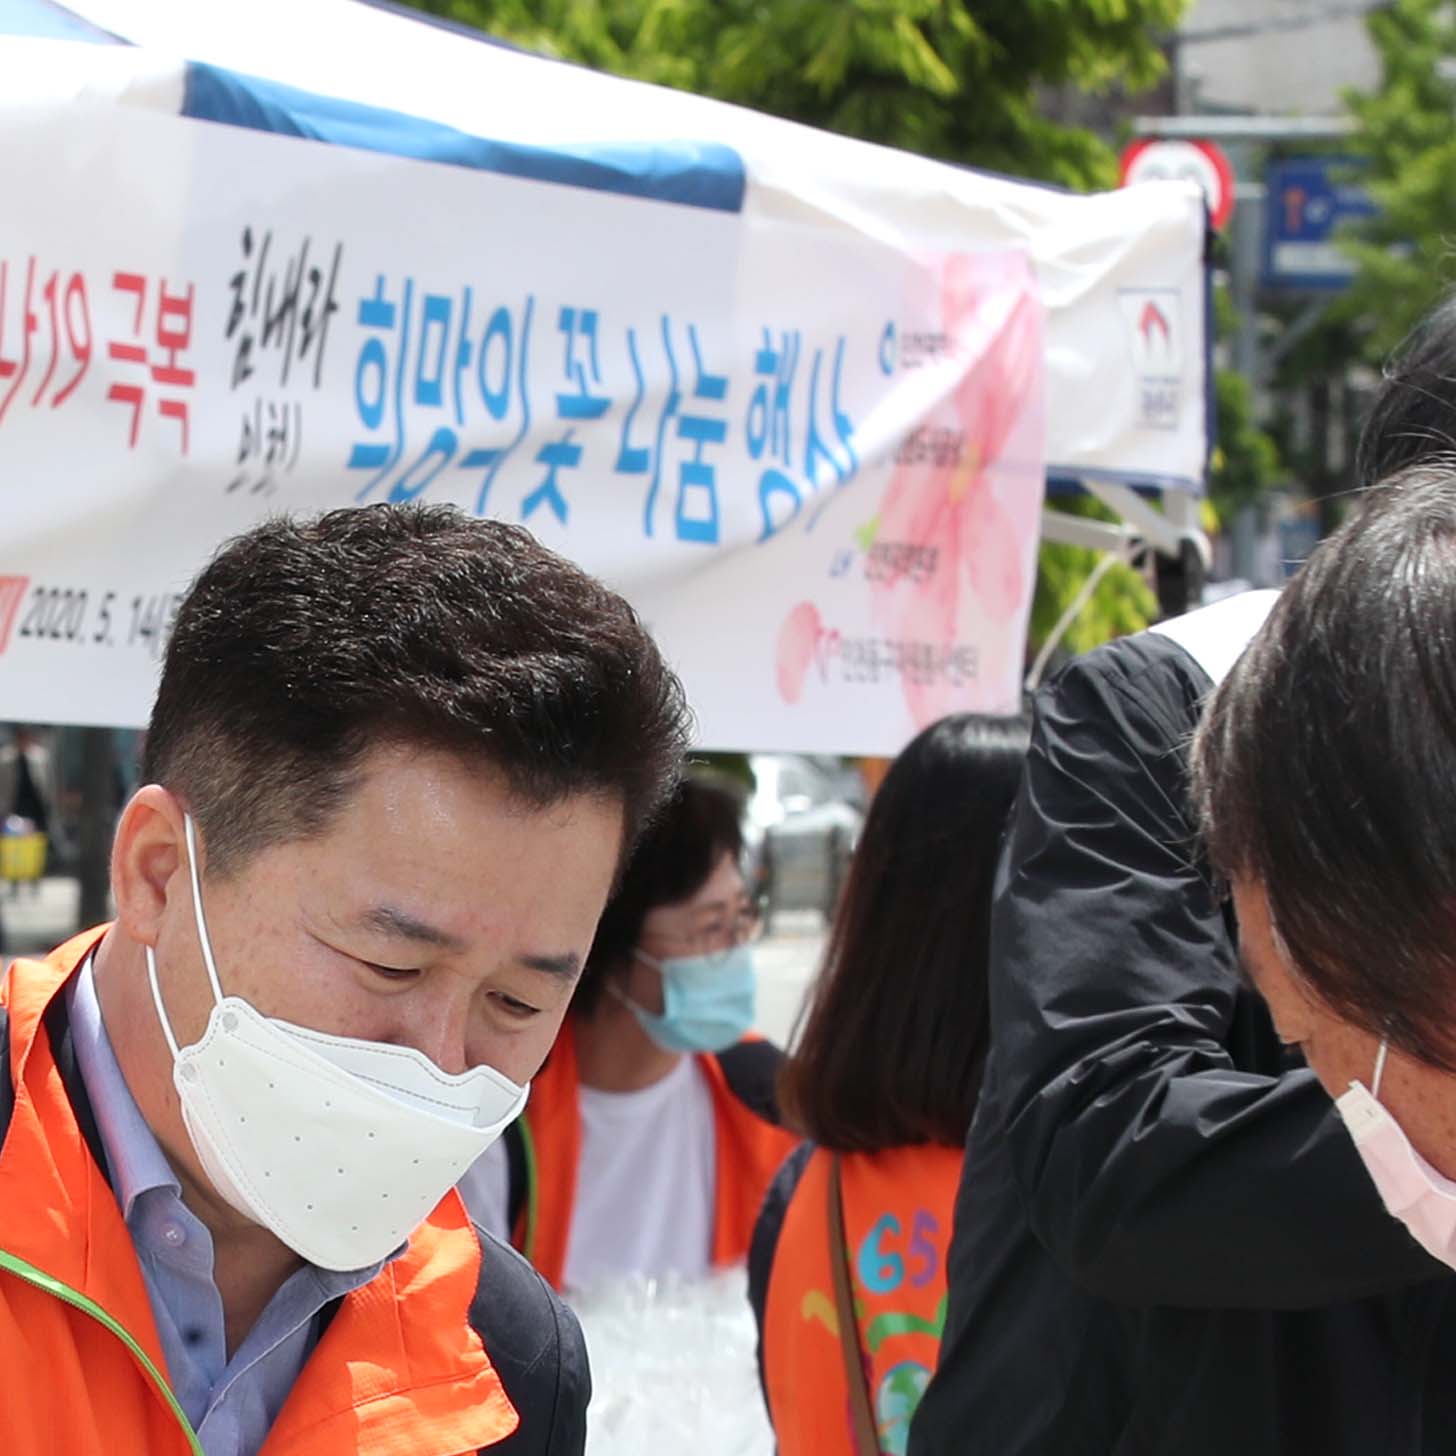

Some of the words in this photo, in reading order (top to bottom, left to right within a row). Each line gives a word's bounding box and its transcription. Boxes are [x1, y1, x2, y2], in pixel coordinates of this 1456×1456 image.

[107, 271, 198, 456] 극복
[346, 273, 537, 514] 희망의
[615, 312, 730, 544] 나눔
[747, 325, 862, 544] 행사
